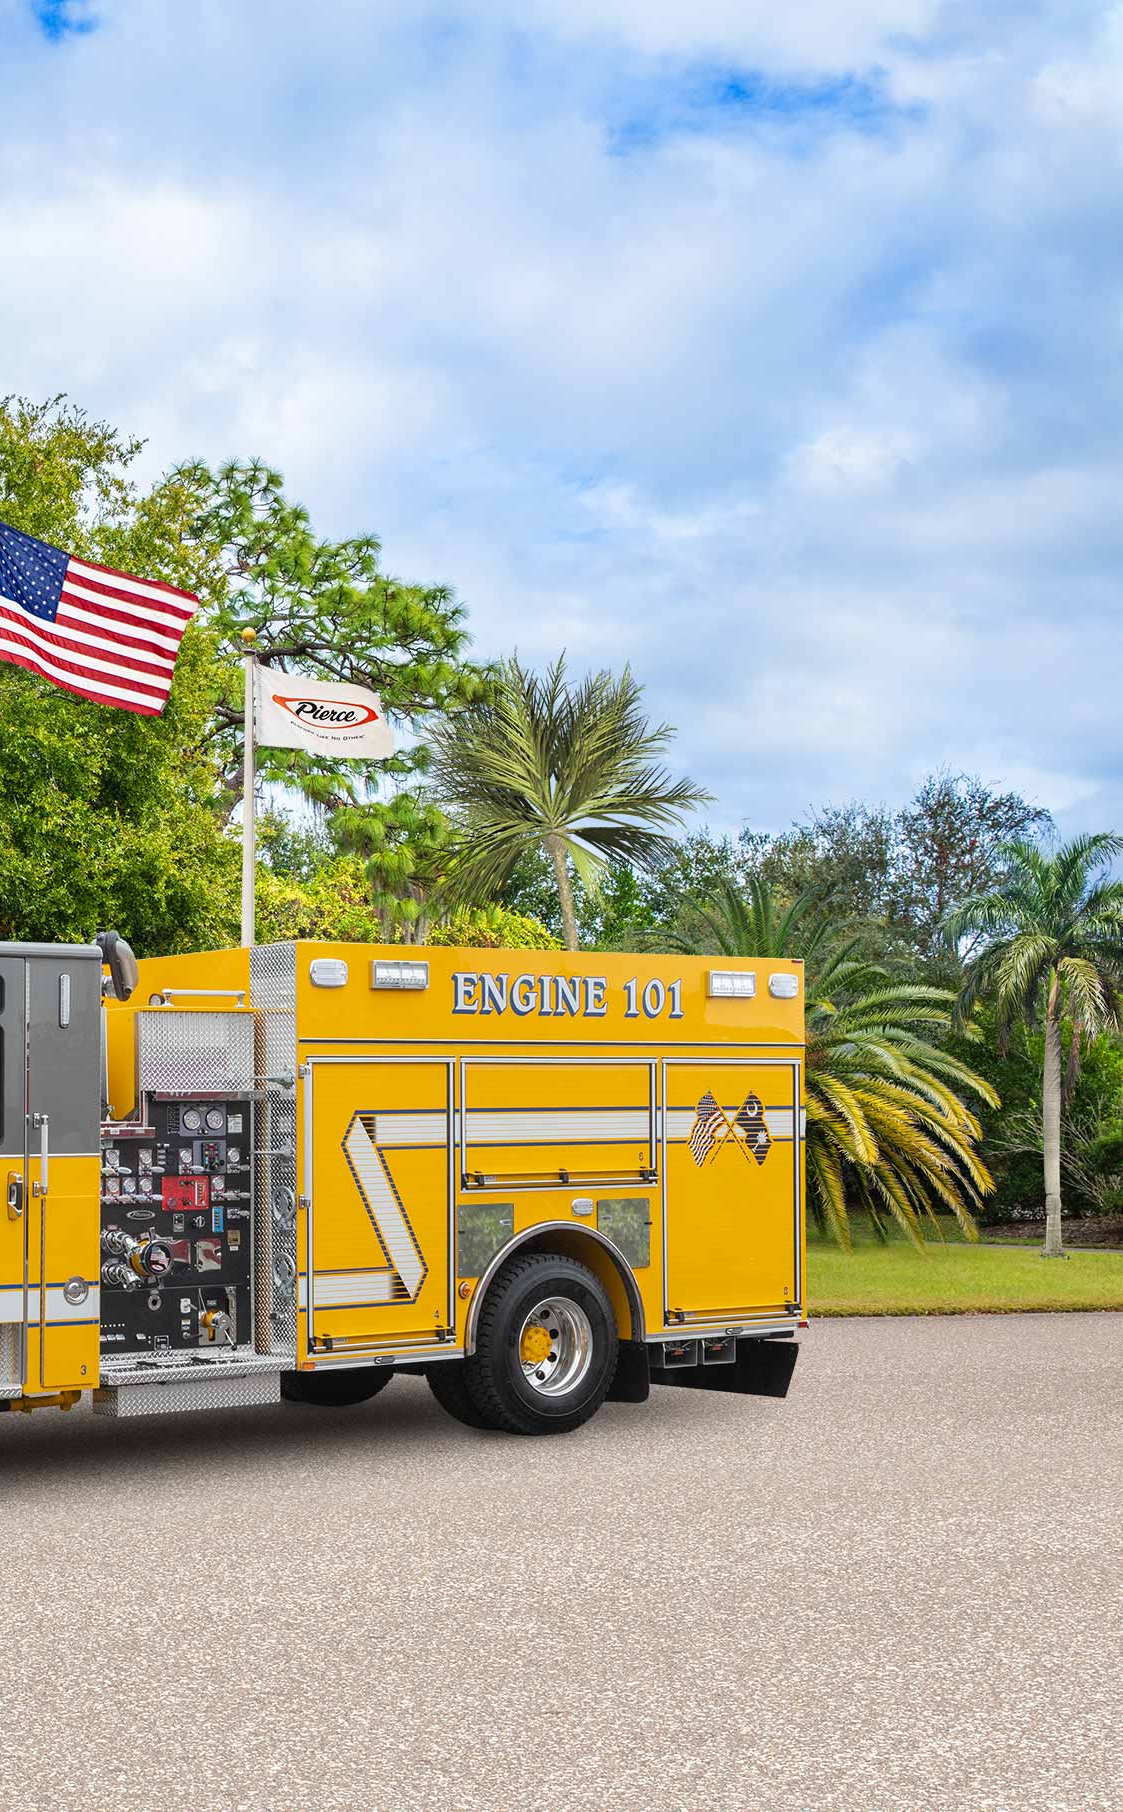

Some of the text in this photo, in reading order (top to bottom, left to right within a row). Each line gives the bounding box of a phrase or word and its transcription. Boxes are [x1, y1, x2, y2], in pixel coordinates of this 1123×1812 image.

[295, 701, 357, 723] Pierce
[452, 972, 684, 1018] ENGINE 101
[80, 1364, 87, 1376] 3
